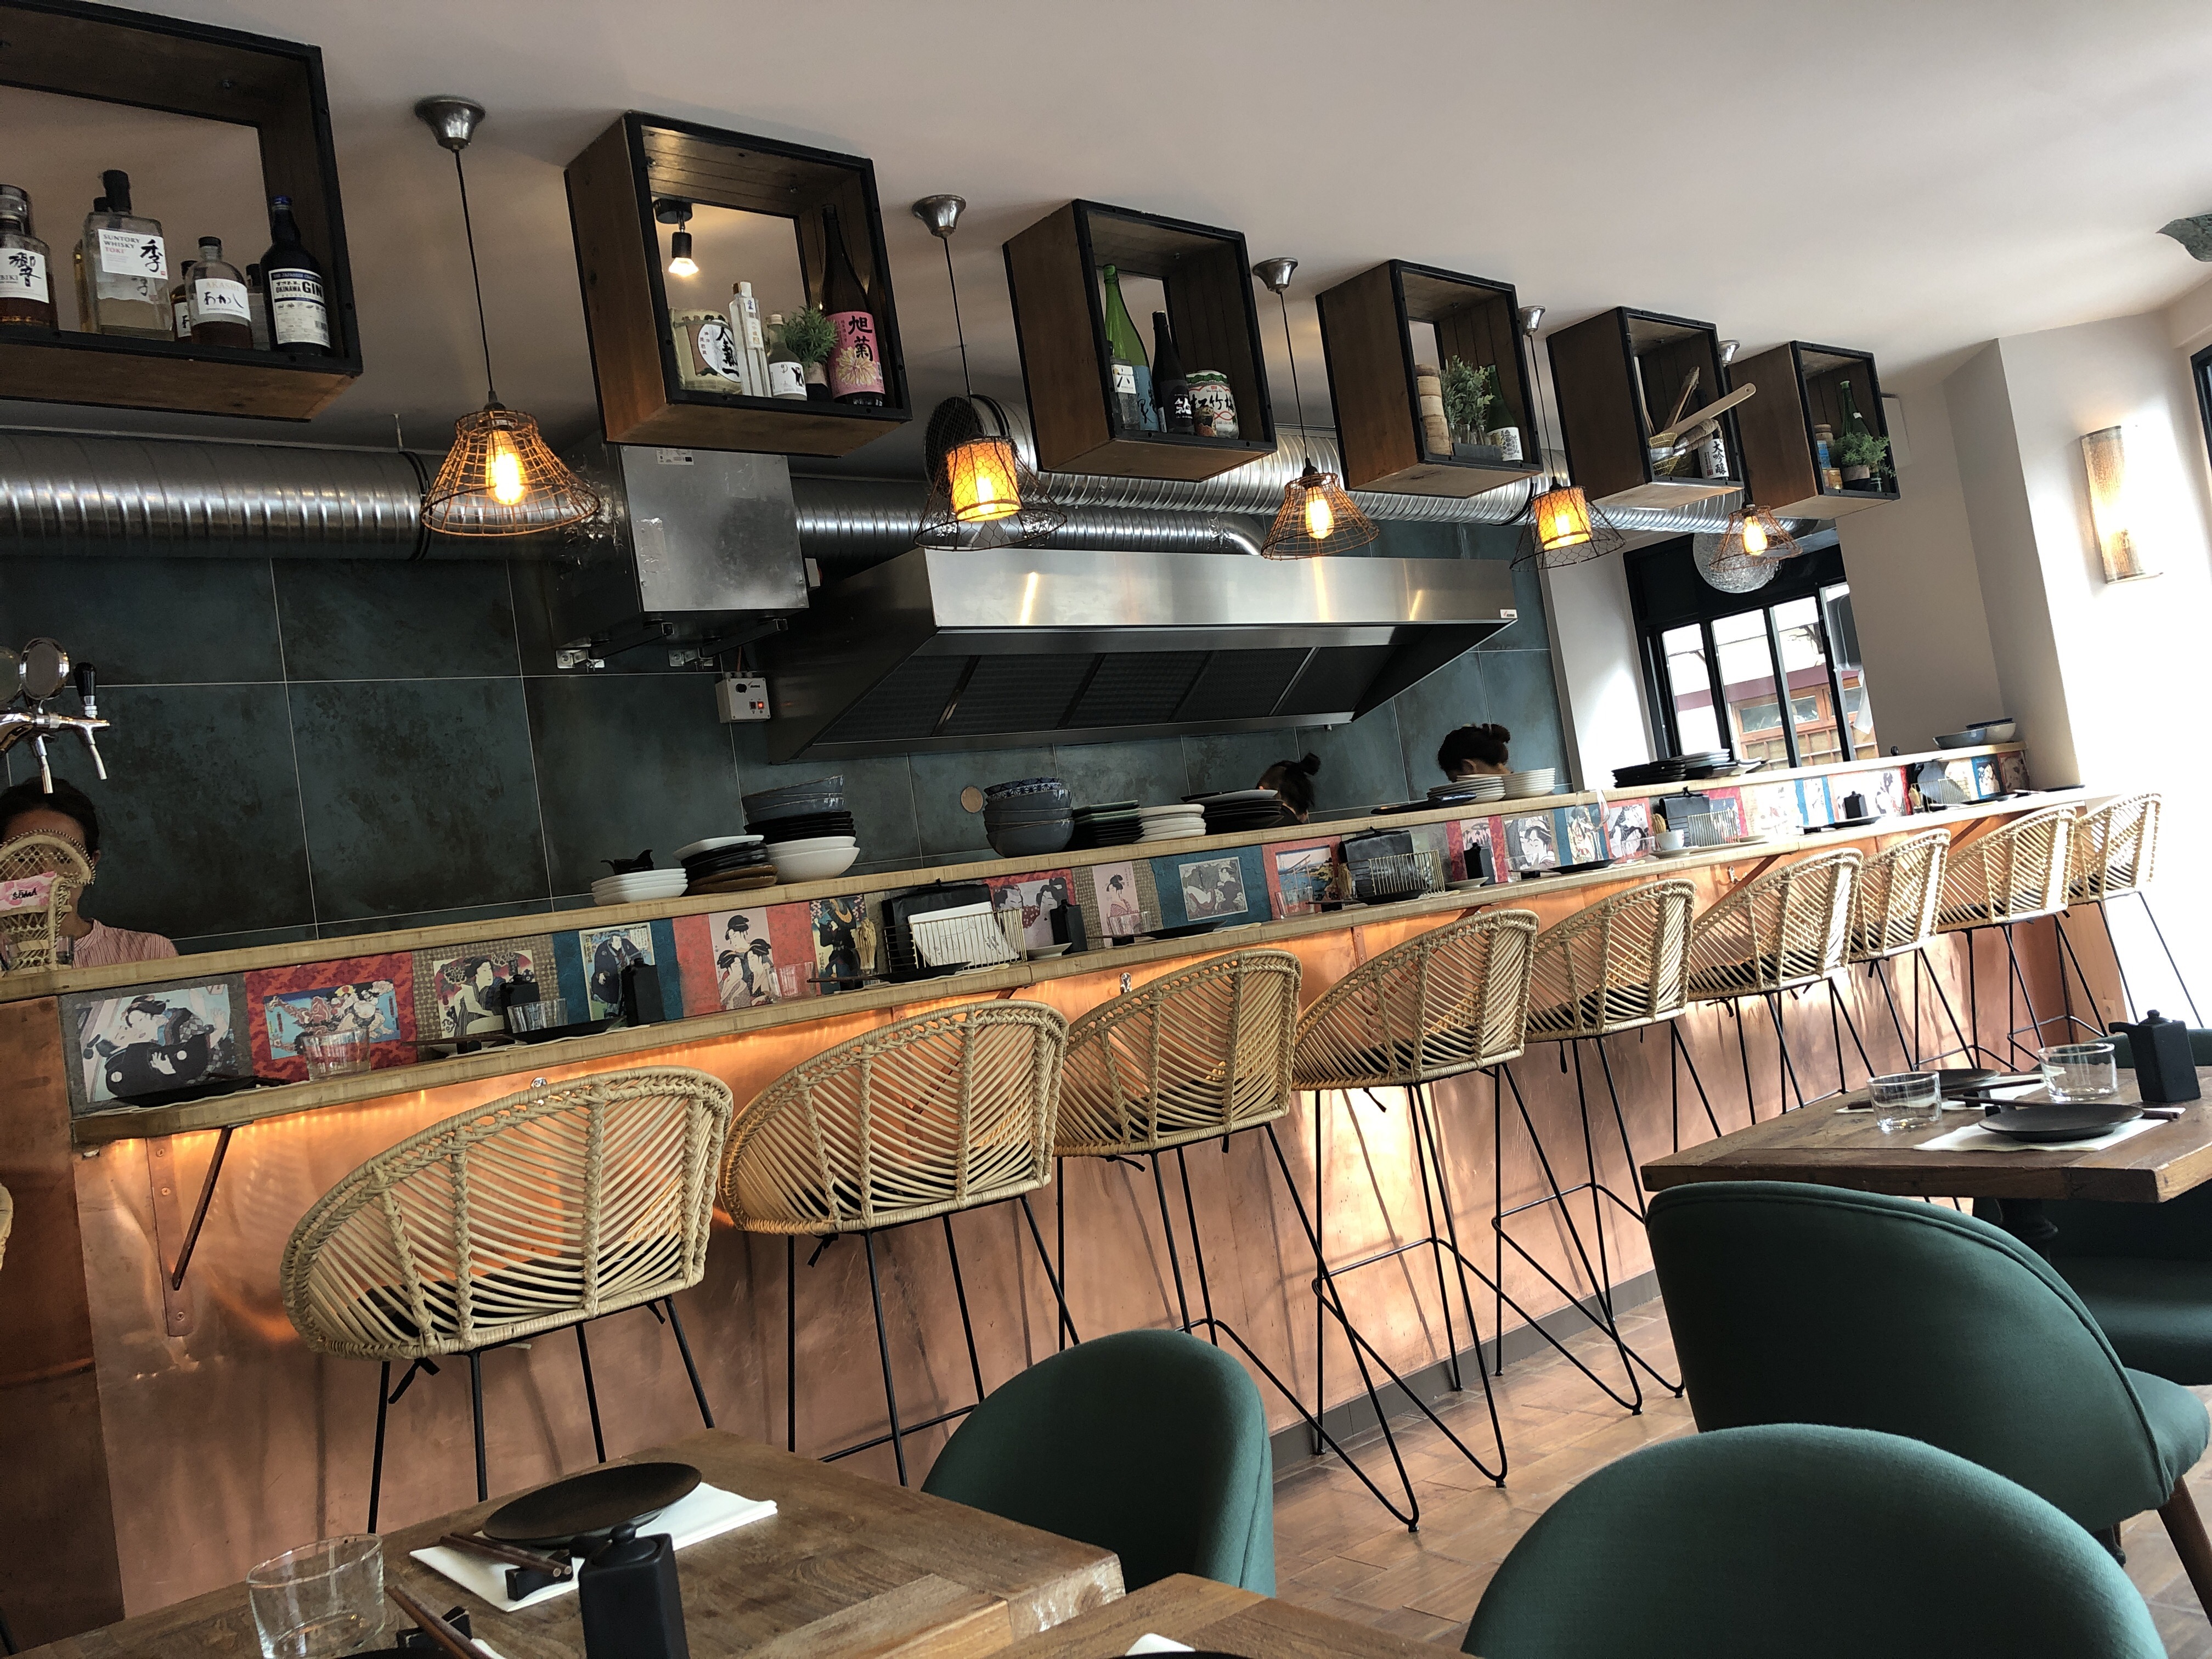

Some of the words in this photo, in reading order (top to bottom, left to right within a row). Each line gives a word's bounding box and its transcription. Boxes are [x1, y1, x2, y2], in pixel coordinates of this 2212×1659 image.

[103, 234, 140, 243] SUNTORY
[103, 240, 134, 249] WHISKY
[140, 239, 163, 273] 季
[206, 282, 239, 291] AKASHI
[302, 281, 323, 298] GIN
[848, 315, 873, 362] 旭菊
